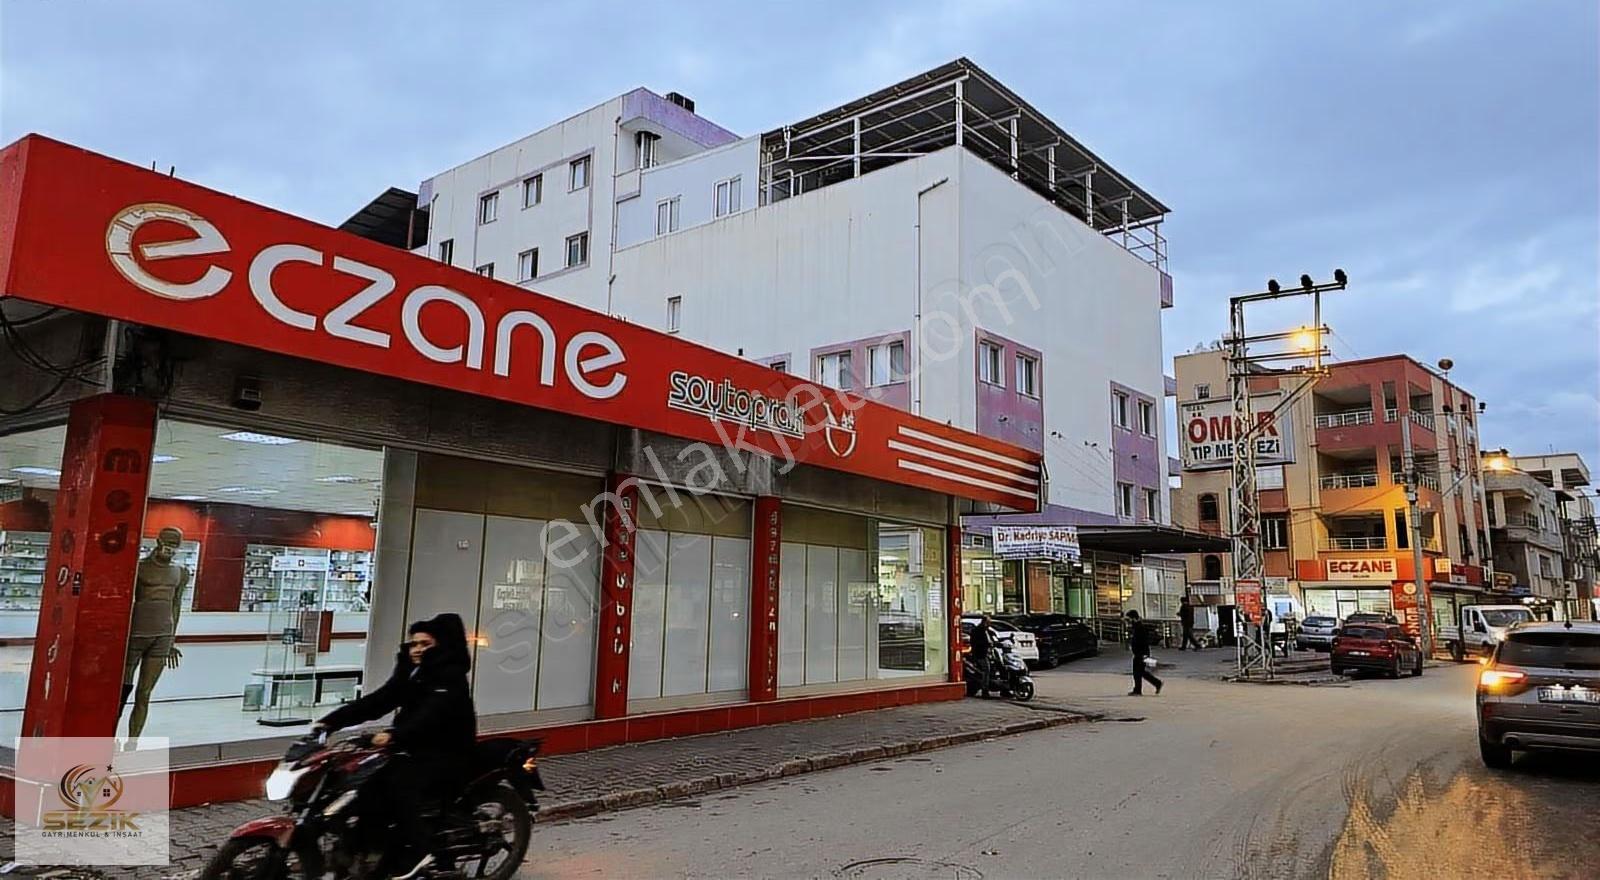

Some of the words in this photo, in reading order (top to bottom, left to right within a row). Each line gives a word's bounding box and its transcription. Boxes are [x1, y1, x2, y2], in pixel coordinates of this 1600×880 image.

[105, 203, 629, 400] eczane
[670, 371, 805, 435] soytoprak
[1191, 445, 1212, 460] TIP
[1329, 561, 1392, 573] ECZANE
